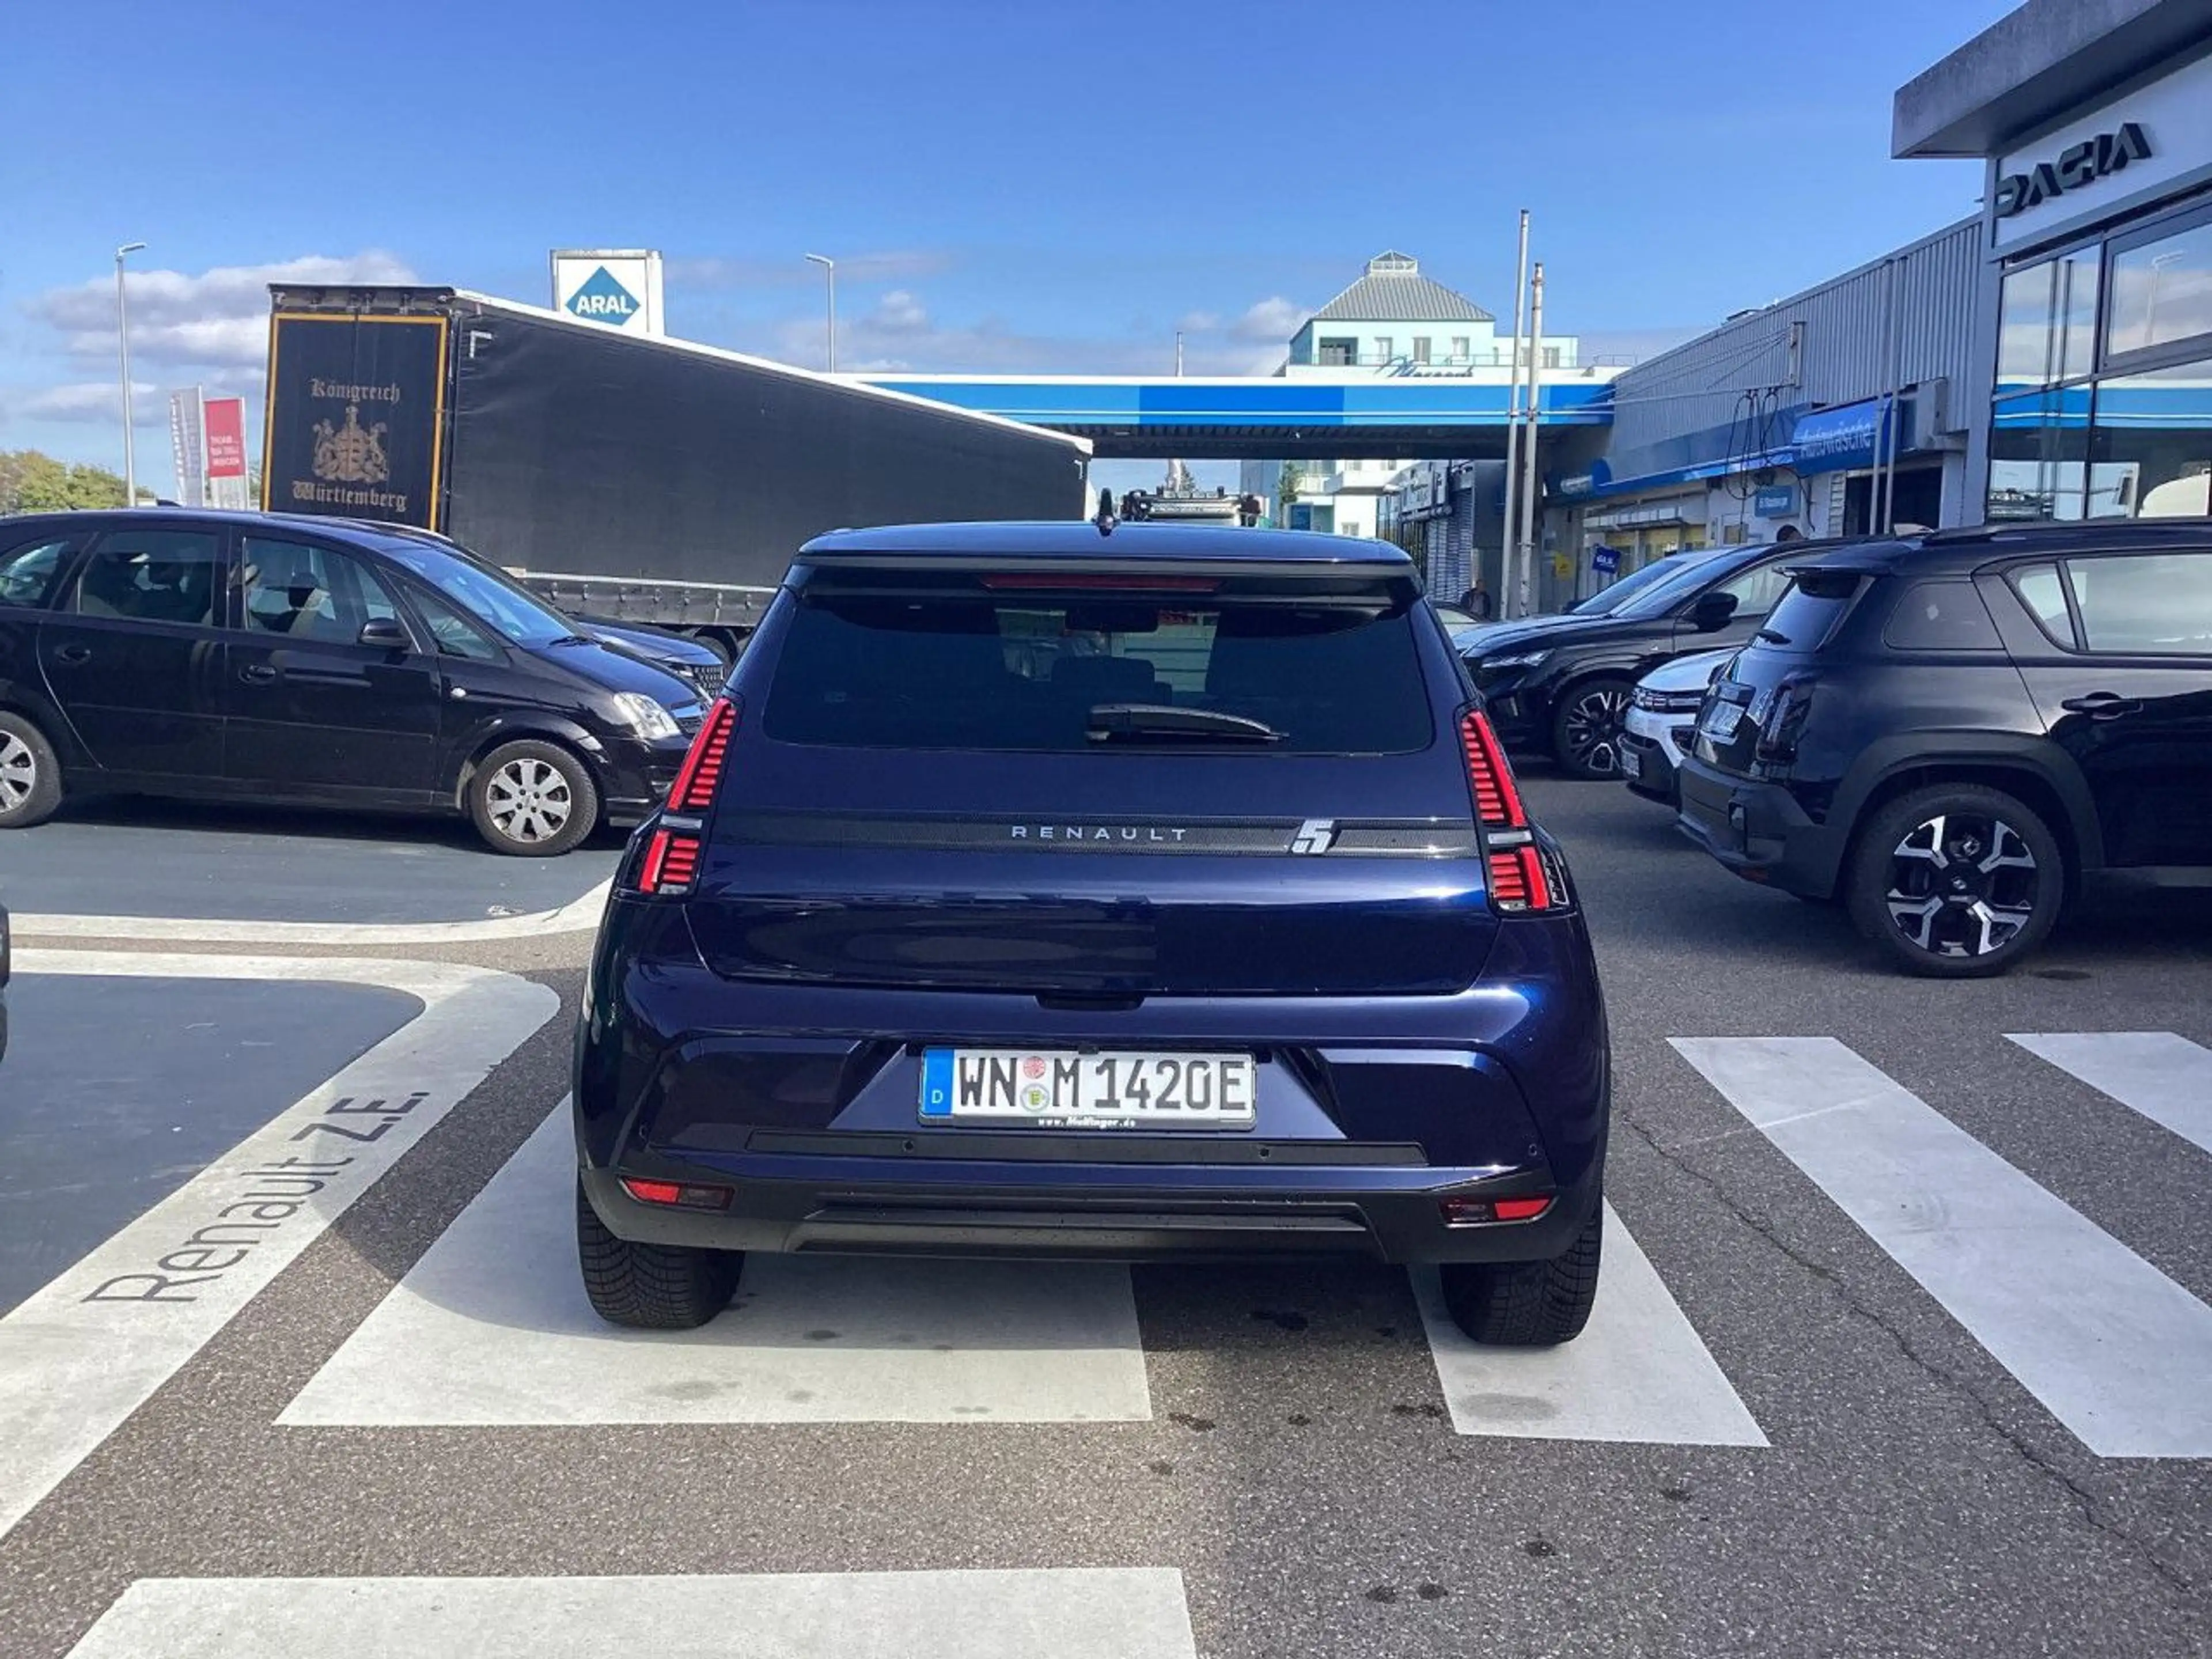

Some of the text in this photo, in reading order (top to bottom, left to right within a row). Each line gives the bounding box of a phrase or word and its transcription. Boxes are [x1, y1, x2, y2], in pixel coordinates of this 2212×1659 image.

[1994, 123, 2152, 218] DACIA
[577, 294, 633, 315] ARAL
[308, 378, 400, 403] Königreich
[291, 480, 407, 512] Württemberg
[1012, 820, 1335, 854] RENAULT 5
[931, 1056, 1247, 1111] D WN M 1420E
[80, 1092, 431, 1303] Renault Z.E.
